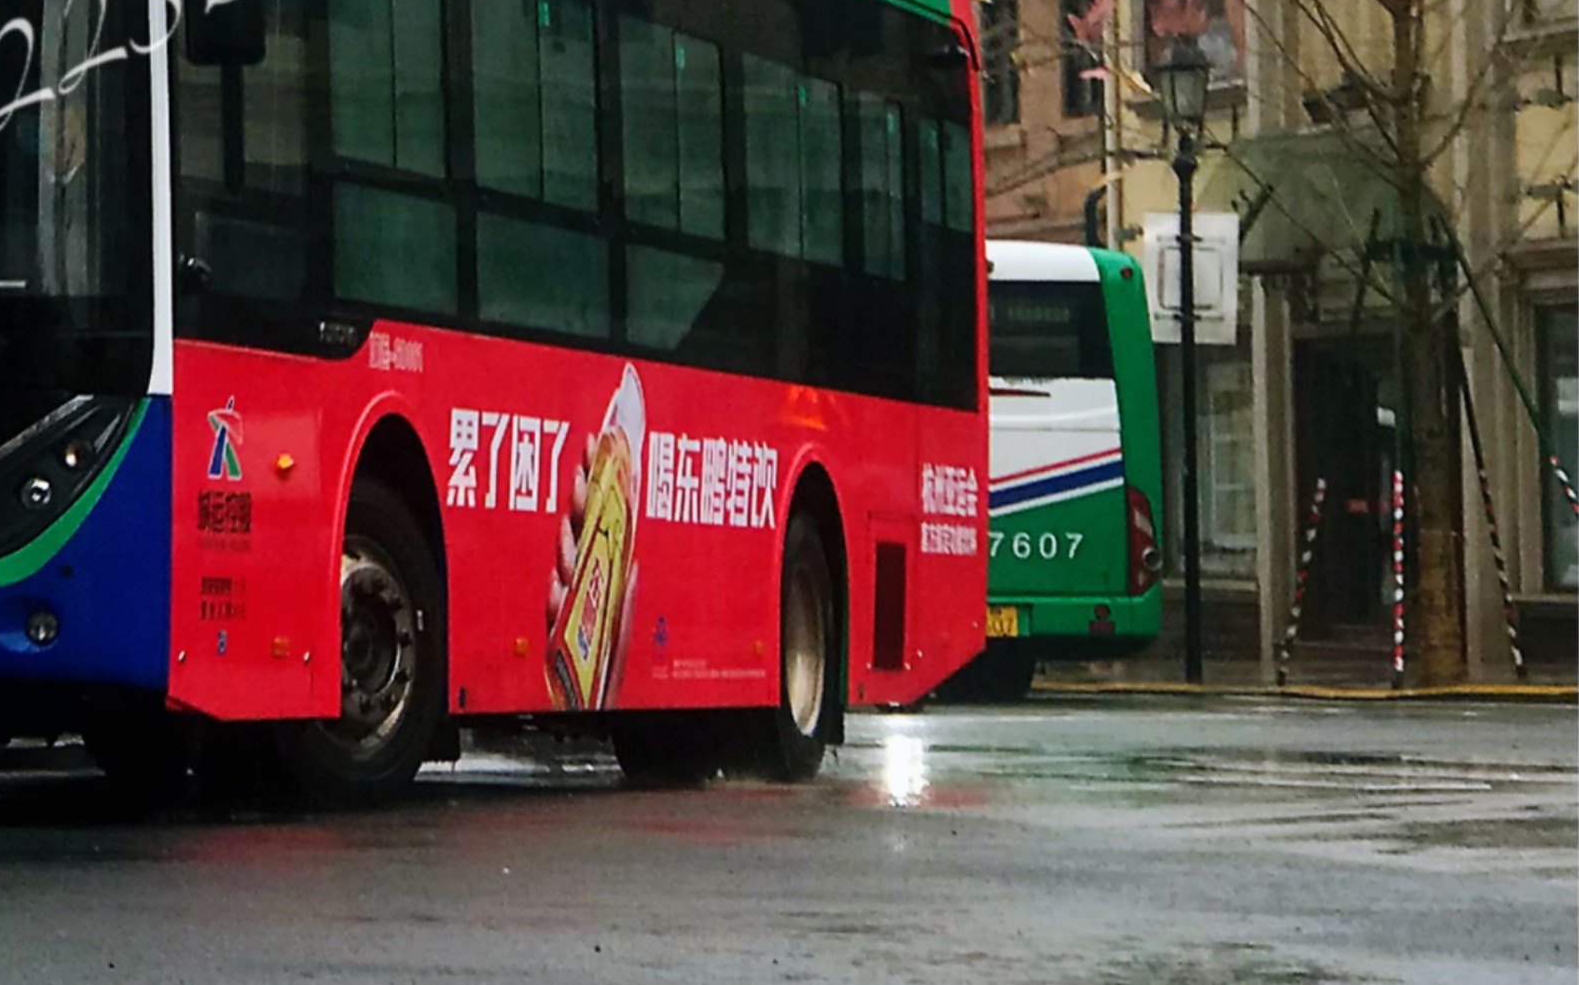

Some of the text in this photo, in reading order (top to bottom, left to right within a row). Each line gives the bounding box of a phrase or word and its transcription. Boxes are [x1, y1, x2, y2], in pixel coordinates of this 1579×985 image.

[446, 408, 778, 530] 累了困了 喝东鹏特饮
[987, 531, 1084, 559] 7607
